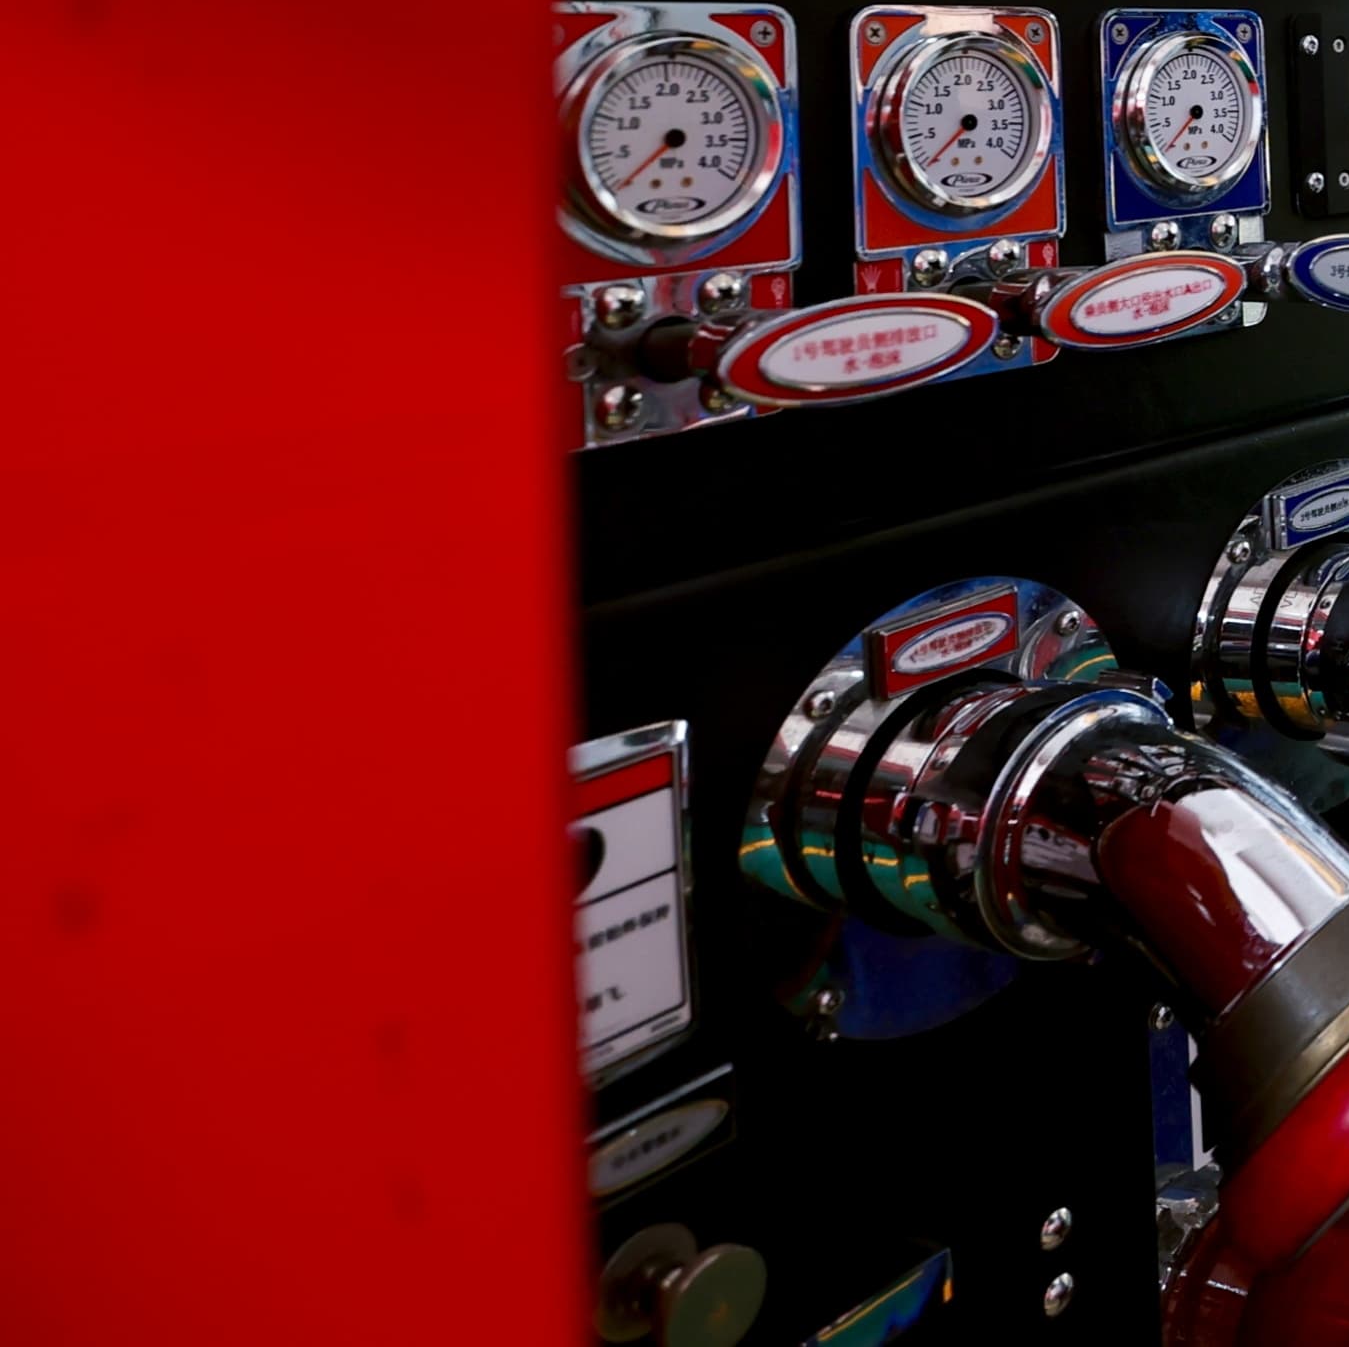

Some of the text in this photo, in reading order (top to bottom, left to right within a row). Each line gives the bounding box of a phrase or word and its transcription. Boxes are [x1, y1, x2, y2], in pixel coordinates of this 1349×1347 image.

[953, 74, 972, 86] 2.0
[1183, 70, 1196, 80] 2.0
[1201, 74, 1215, 85] 2.5
[655, 83, 680, 97] 2.0
[934, 85, 951, 98] 1.5
[976, 80, 994, 92] 2.5
[1167, 80, 1181, 91] 1.5
[685, 89, 710, 104] 2.5
[1161, 96, 1175, 106] 1.0
[1210, 90, 1224, 101] 3.0
[628, 96, 651, 110] 1.5
[988, 99, 1005, 111] 3.0
[925, 103, 943, 116] 1.0
[1213, 108, 1227, 118] 3.5
[616, 116, 640, 131] 1.0
[701, 111, 723, 125] 3.0
[991, 118, 1009, 131] 3.5
[1188, 125, 1202, 135] MPa
[1210, 124, 1224, 134] 4.0
[705, 134, 728, 148] 3.5
[957, 138, 976, 149] MPa
[985, 136, 1004, 149] 4.0
[659, 157, 685, 171] MPa
[698, 155, 721, 169] 4.0
